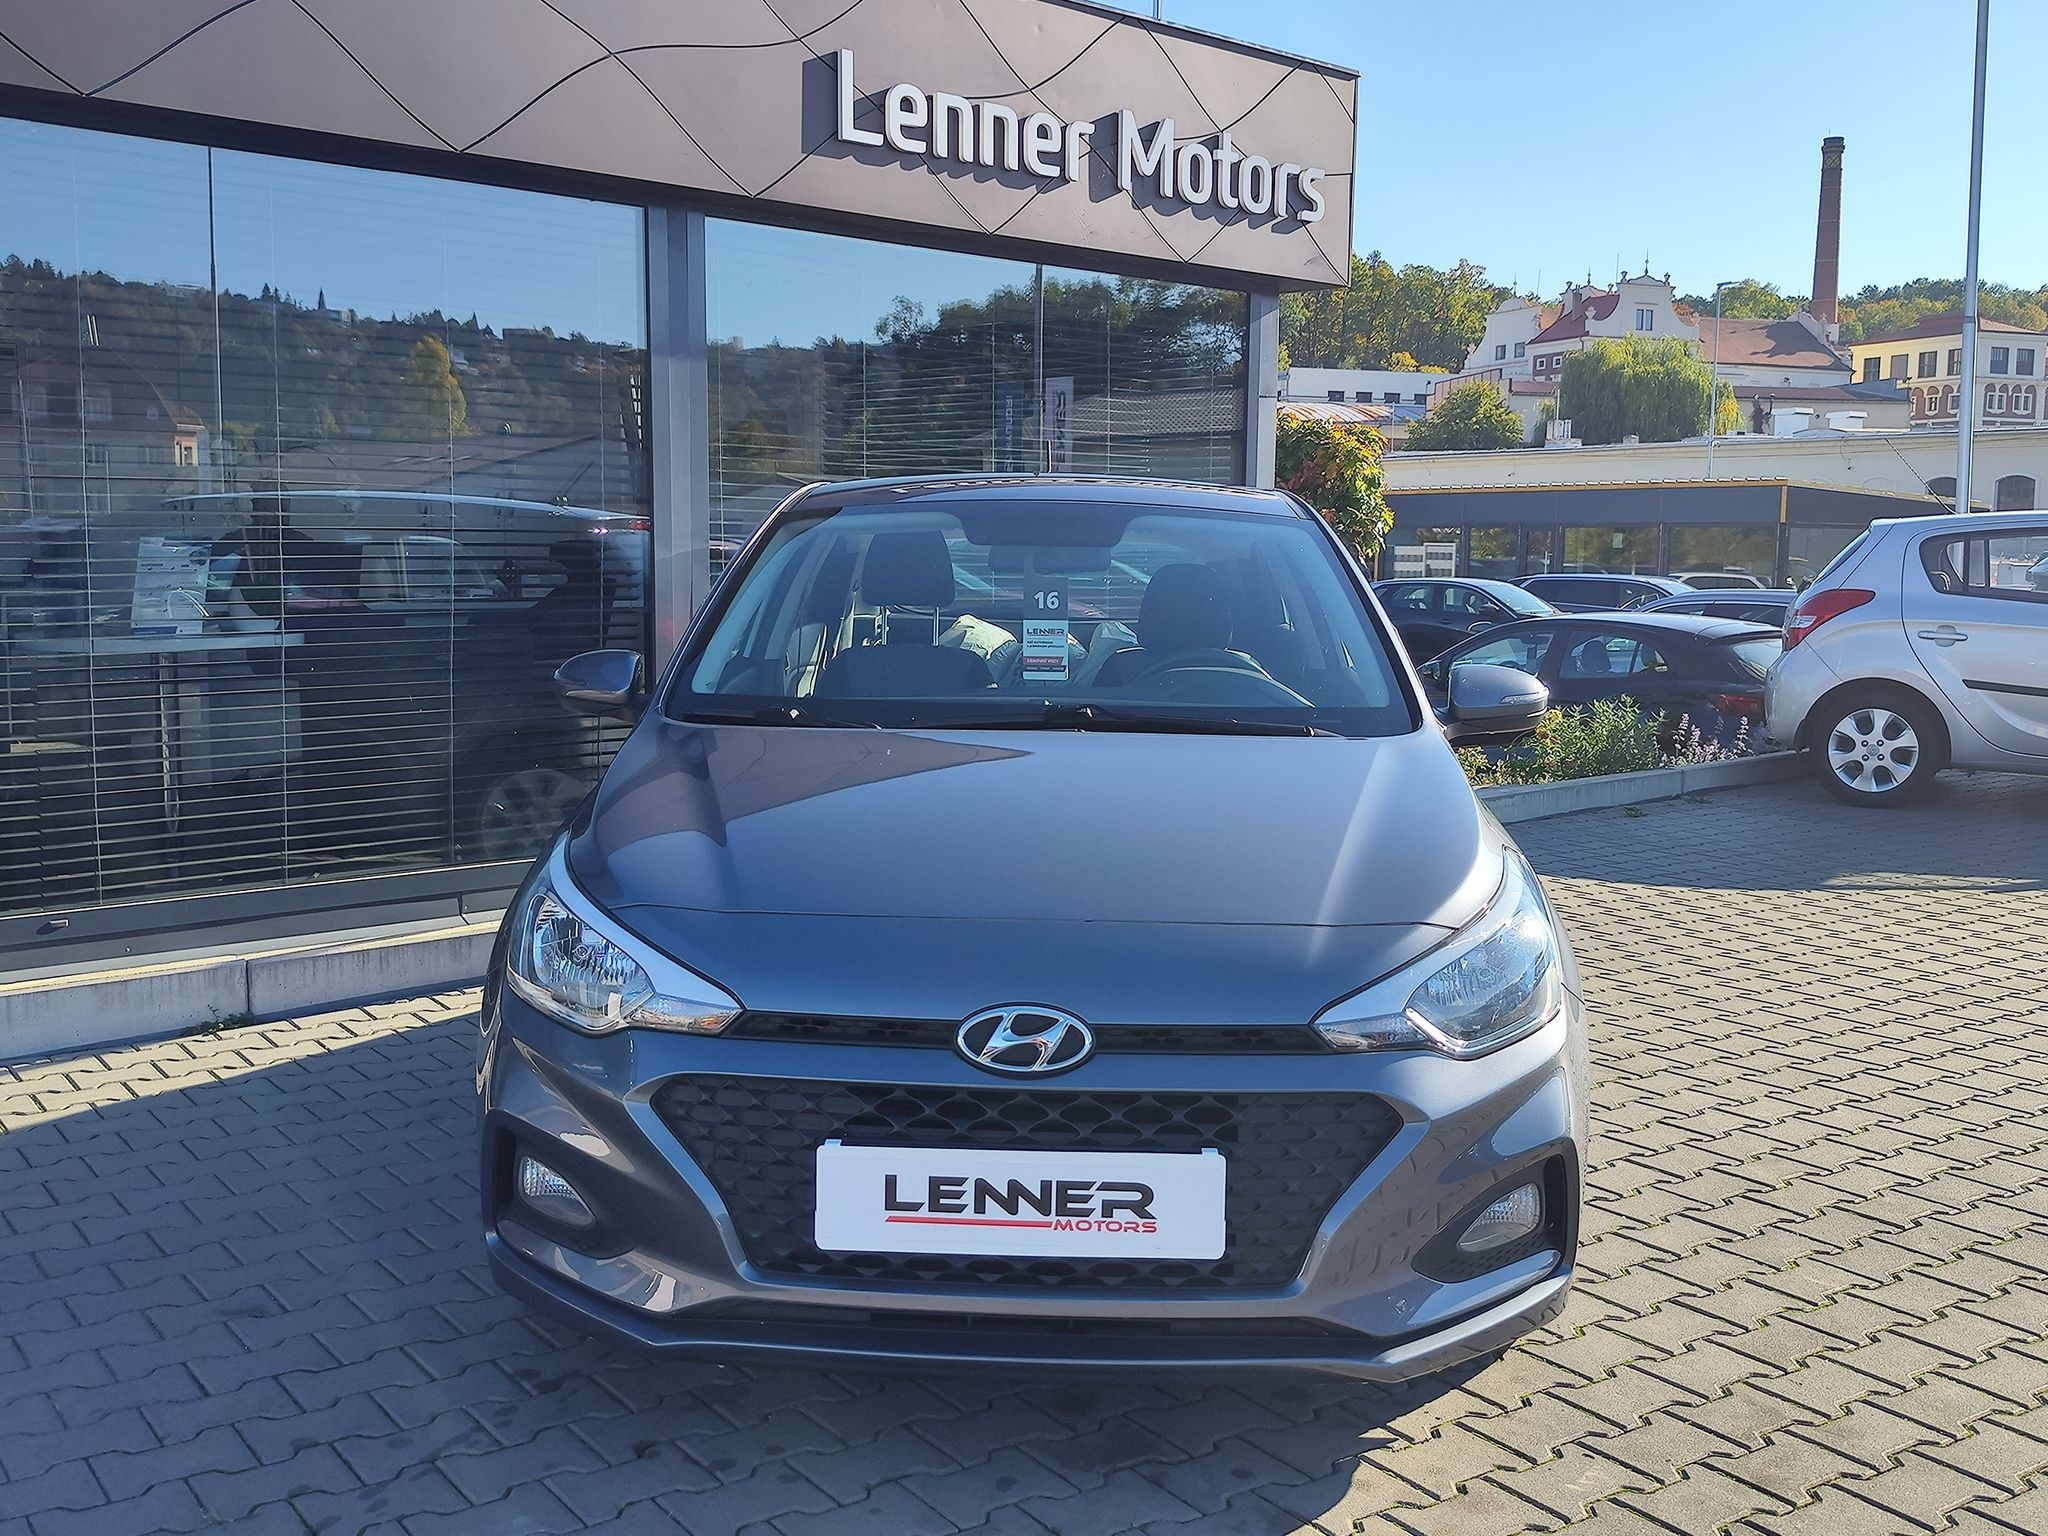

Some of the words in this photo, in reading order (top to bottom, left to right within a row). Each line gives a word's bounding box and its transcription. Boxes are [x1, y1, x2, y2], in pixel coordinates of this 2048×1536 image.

[837, 49, 1095, 182] Lenner
[1118, 109, 1326, 223] Motors
[1034, 592, 1059, 609] 16
[884, 1173, 1157, 1219] LENNER
[1053, 1218, 1158, 1233] MOTORS
